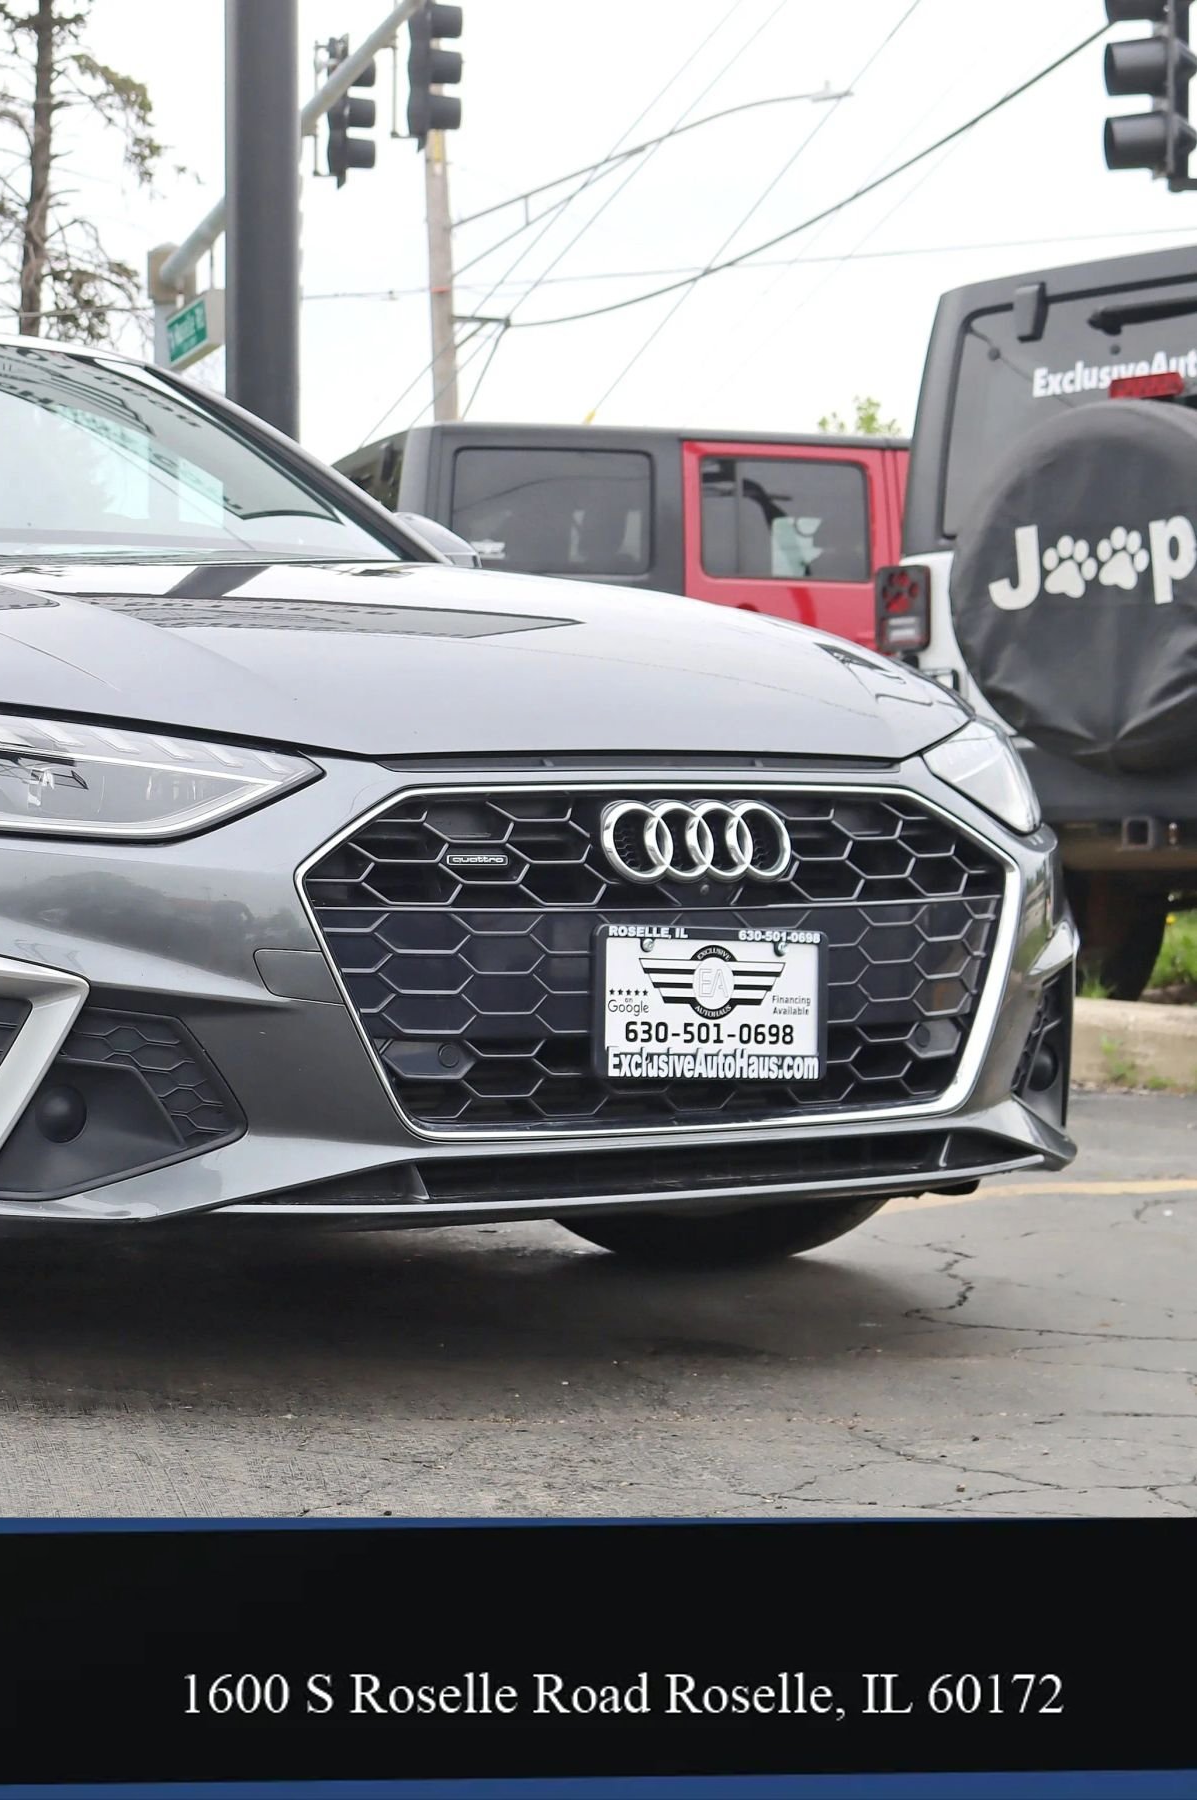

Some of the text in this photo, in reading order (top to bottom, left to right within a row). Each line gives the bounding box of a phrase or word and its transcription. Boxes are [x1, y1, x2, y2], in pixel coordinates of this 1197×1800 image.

[452, 856, 504, 864] quattro
[608, 925, 688, 939] ROSELLE, IL
[738, 930, 821, 943] 630-501-0698
[697, 947, 731, 961] EXCLUSIVE
[699, 967, 729, 998] EA
[607, 999, 649, 1016] Google
[772, 995, 811, 1007] Financing
[694, 1004, 732, 1018] AUTOHAUS
[773, 1006, 810, 1016] Available
[625, 1021, 794, 1045] 630-501-0698
[607, 1046, 819, 1080] ExclusiveAutoHaus.com
